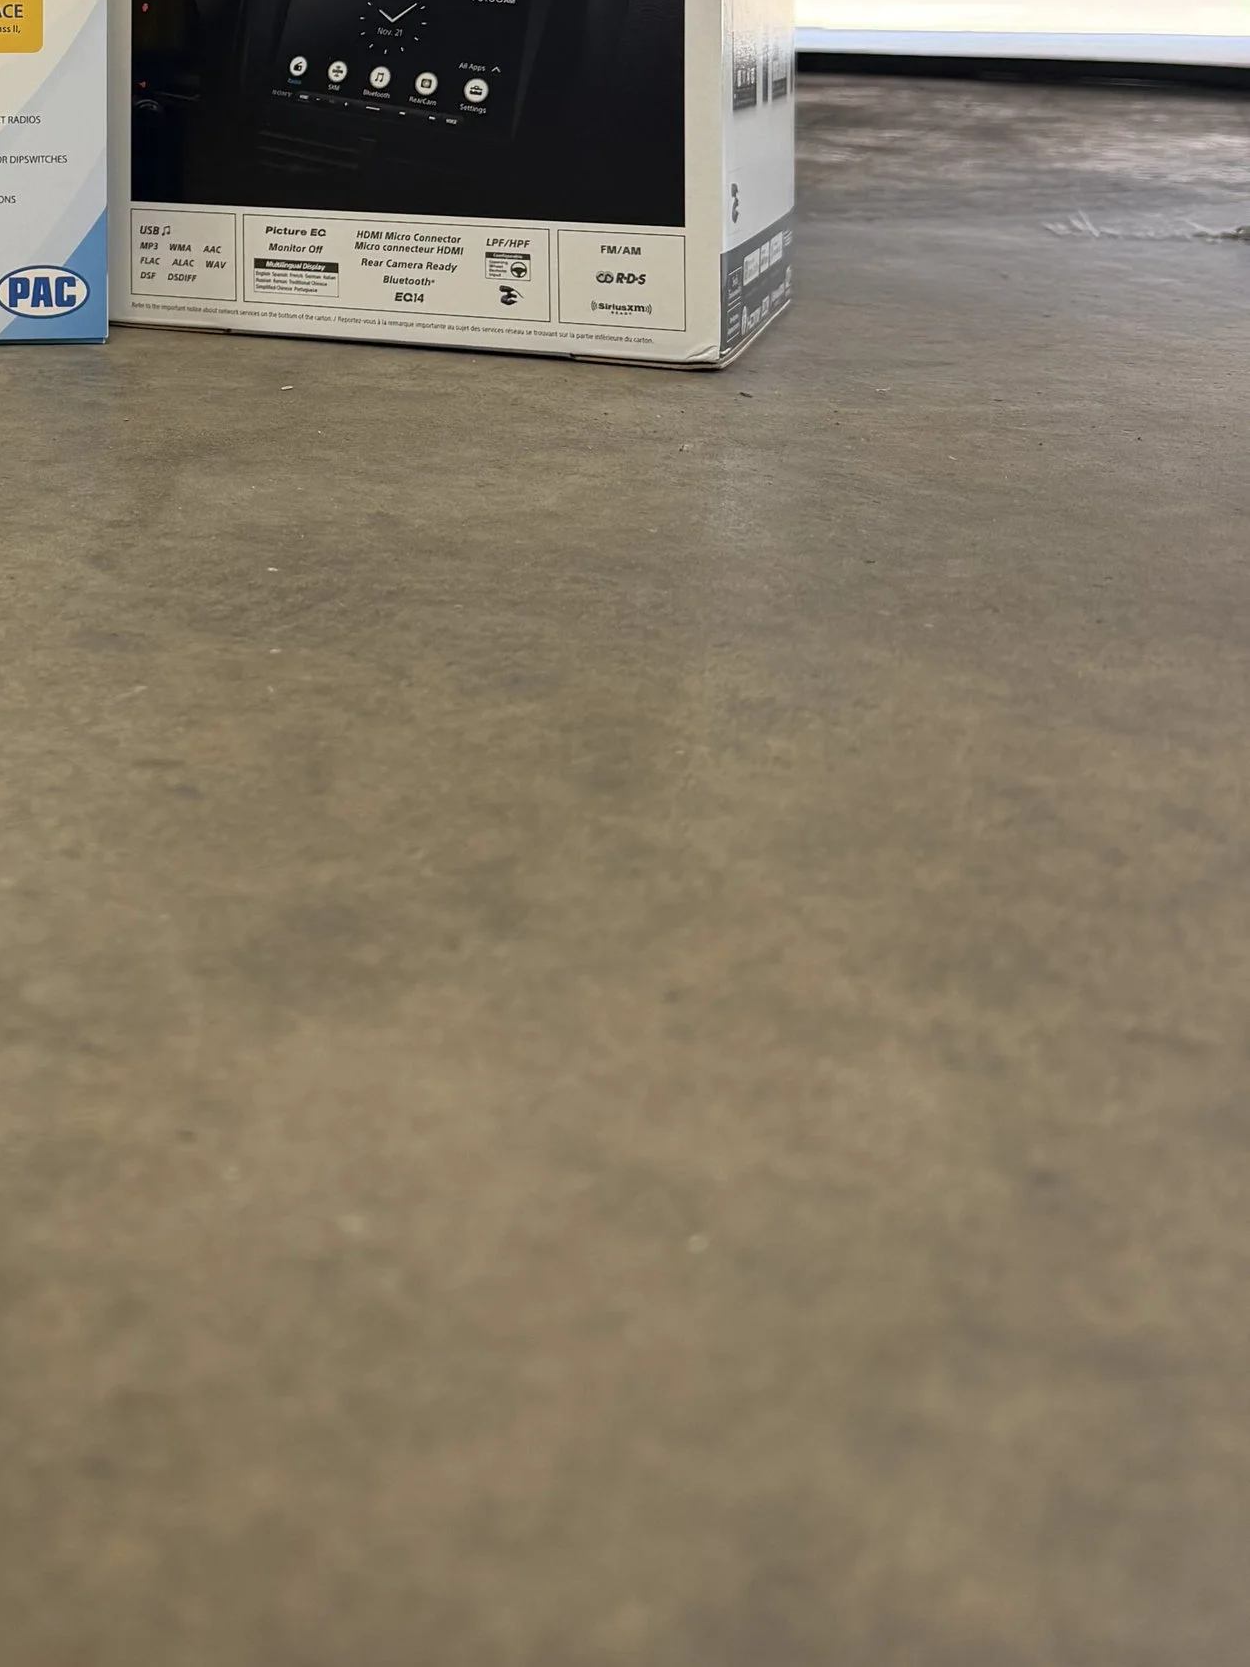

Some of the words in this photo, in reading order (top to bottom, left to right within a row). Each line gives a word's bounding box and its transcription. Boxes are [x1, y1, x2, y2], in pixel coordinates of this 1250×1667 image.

[460, 104, 486, 114] Settings
[8, 116, 41, 124] RADIOS
[9, 155, 68, 164] DIPSWITCHES
[140, 226, 159, 235] USB
[265, 226, 307, 236] Picture
[356, 230, 383, 239] HDMI
[385, 232, 410, 241] Micro
[414, 233, 461, 244] Connector
[140, 242, 158, 250] MP3
[169, 244, 191, 252] WMA
[486, 238, 530, 248] LPF/HPF
[269, 243, 306, 252] Monitor
[308, 245, 323, 254] Off
[355, 242, 380, 250] Micro
[383, 244, 434, 253] connecteur
[436, 246, 464, 255] HDMI
[600, 245, 641, 255] FM/AM
[140, 257, 160, 265] FLAC
[172, 259, 194, 267] ALAC
[206, 261, 226, 269] WAV
[303, 262, 325, 271] Display
[361, 258, 384, 267] Rear
[386, 259, 423, 269] Camera
[426, 262, 458, 273] Ready
[8, 276, 77, 308] PAC
